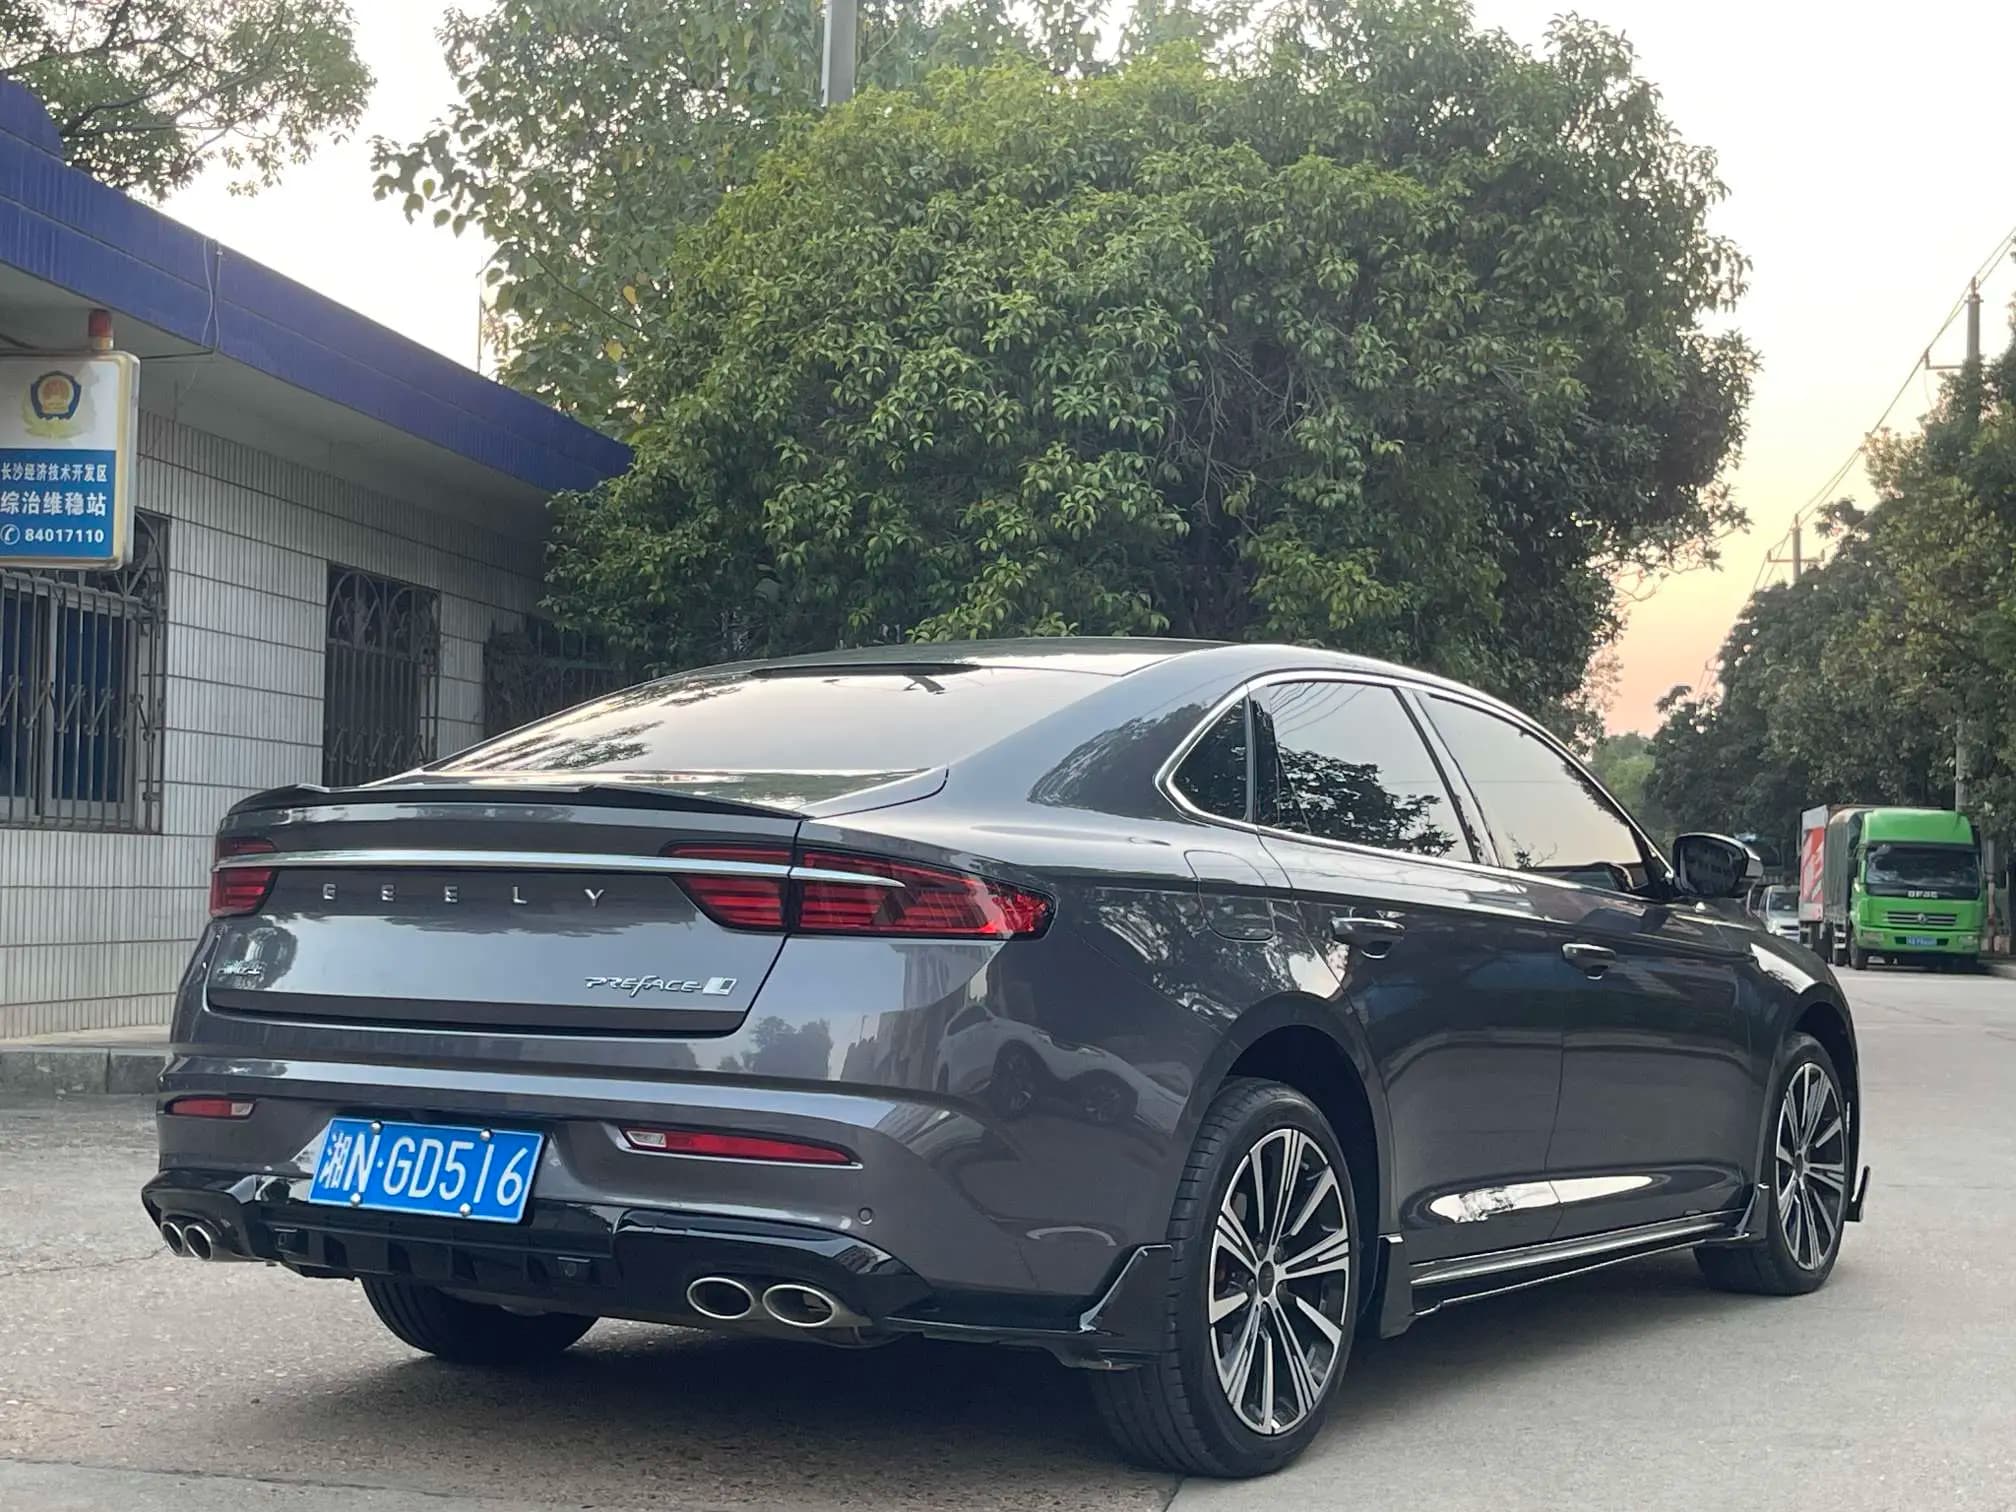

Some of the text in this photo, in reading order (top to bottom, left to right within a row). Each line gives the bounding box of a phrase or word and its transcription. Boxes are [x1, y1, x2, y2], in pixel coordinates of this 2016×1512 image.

[1, 462, 107, 482] 长沙经济技术开发区
[0, 490, 106, 517] 综治维稳站
[24, 528, 105, 543] 84017110
[322, 883, 604, 907] GEELY
